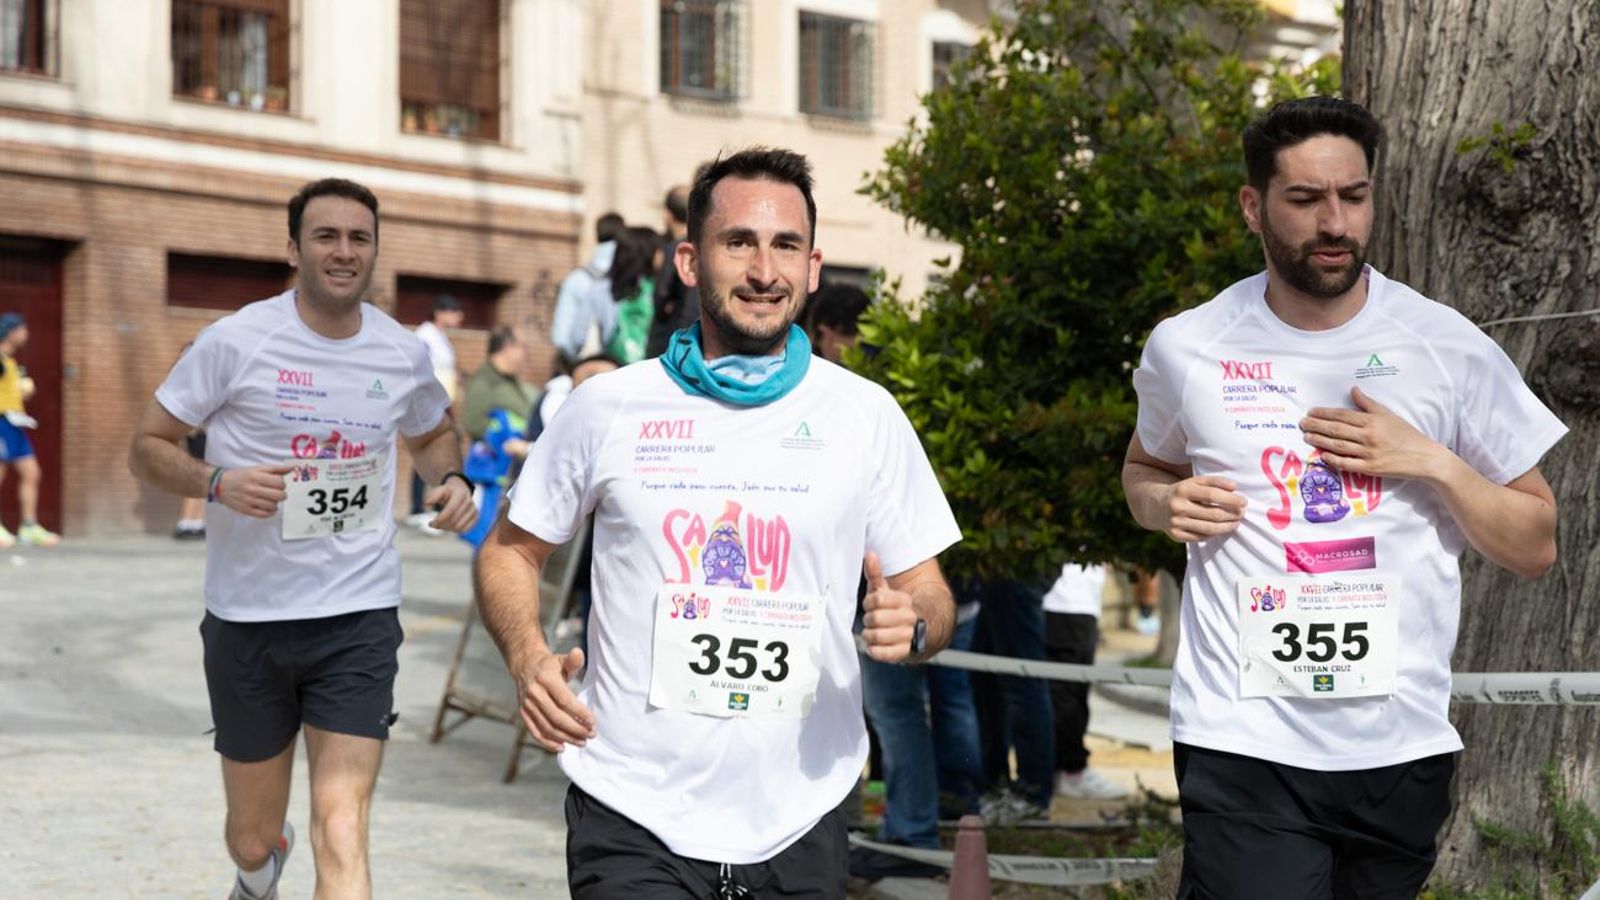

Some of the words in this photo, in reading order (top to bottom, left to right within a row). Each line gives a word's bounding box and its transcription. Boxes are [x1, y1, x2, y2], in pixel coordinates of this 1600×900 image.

[277, 369, 314, 386] XXVII
[1219, 360, 1273, 380] XXVII
[1222, 386, 1257, 394] CARRERA
[1259, 385, 1296, 394] POPULAR
[638, 419, 695, 439] XXVII
[1235, 420, 1259, 430] Porque
[1262, 420, 1278, 428] cada
[306, 484, 368, 516] 354
[1316, 549, 1368, 560] MACROSAD
[1352, 583, 1384, 592] POPULAR
[1271, 622, 1370, 662] 355
[688, 633, 789, 682] 353
